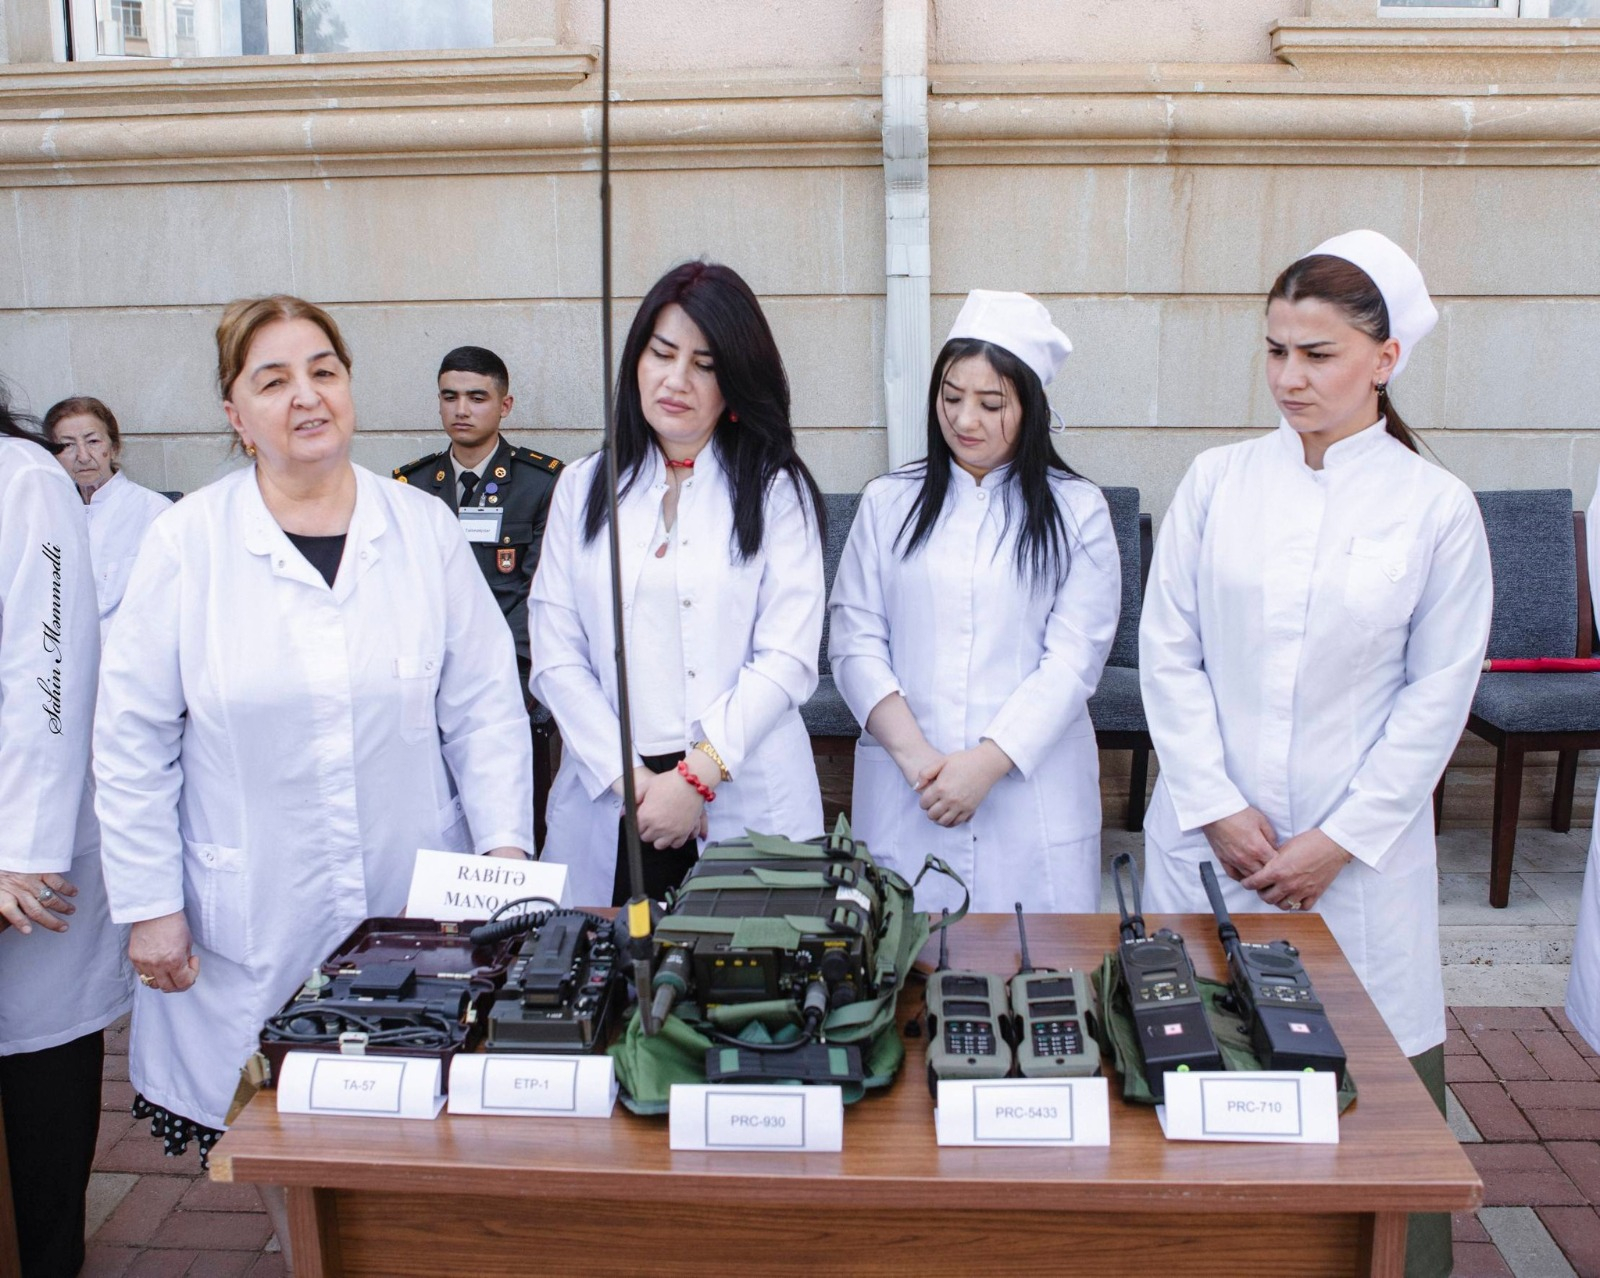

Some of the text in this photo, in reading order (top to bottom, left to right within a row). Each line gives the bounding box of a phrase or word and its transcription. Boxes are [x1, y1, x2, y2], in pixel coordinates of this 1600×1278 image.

[457, 865, 526, 886] RABİTƏ
[343, 1079, 376, 1092] TA-57
[513, 1077, 549, 1090] ETP-1
[995, 1105, 1058, 1119] PRC-5433
[1227, 1100, 1282, 1113] PRC-710
[730, 1114, 786, 1128] PRC-930
